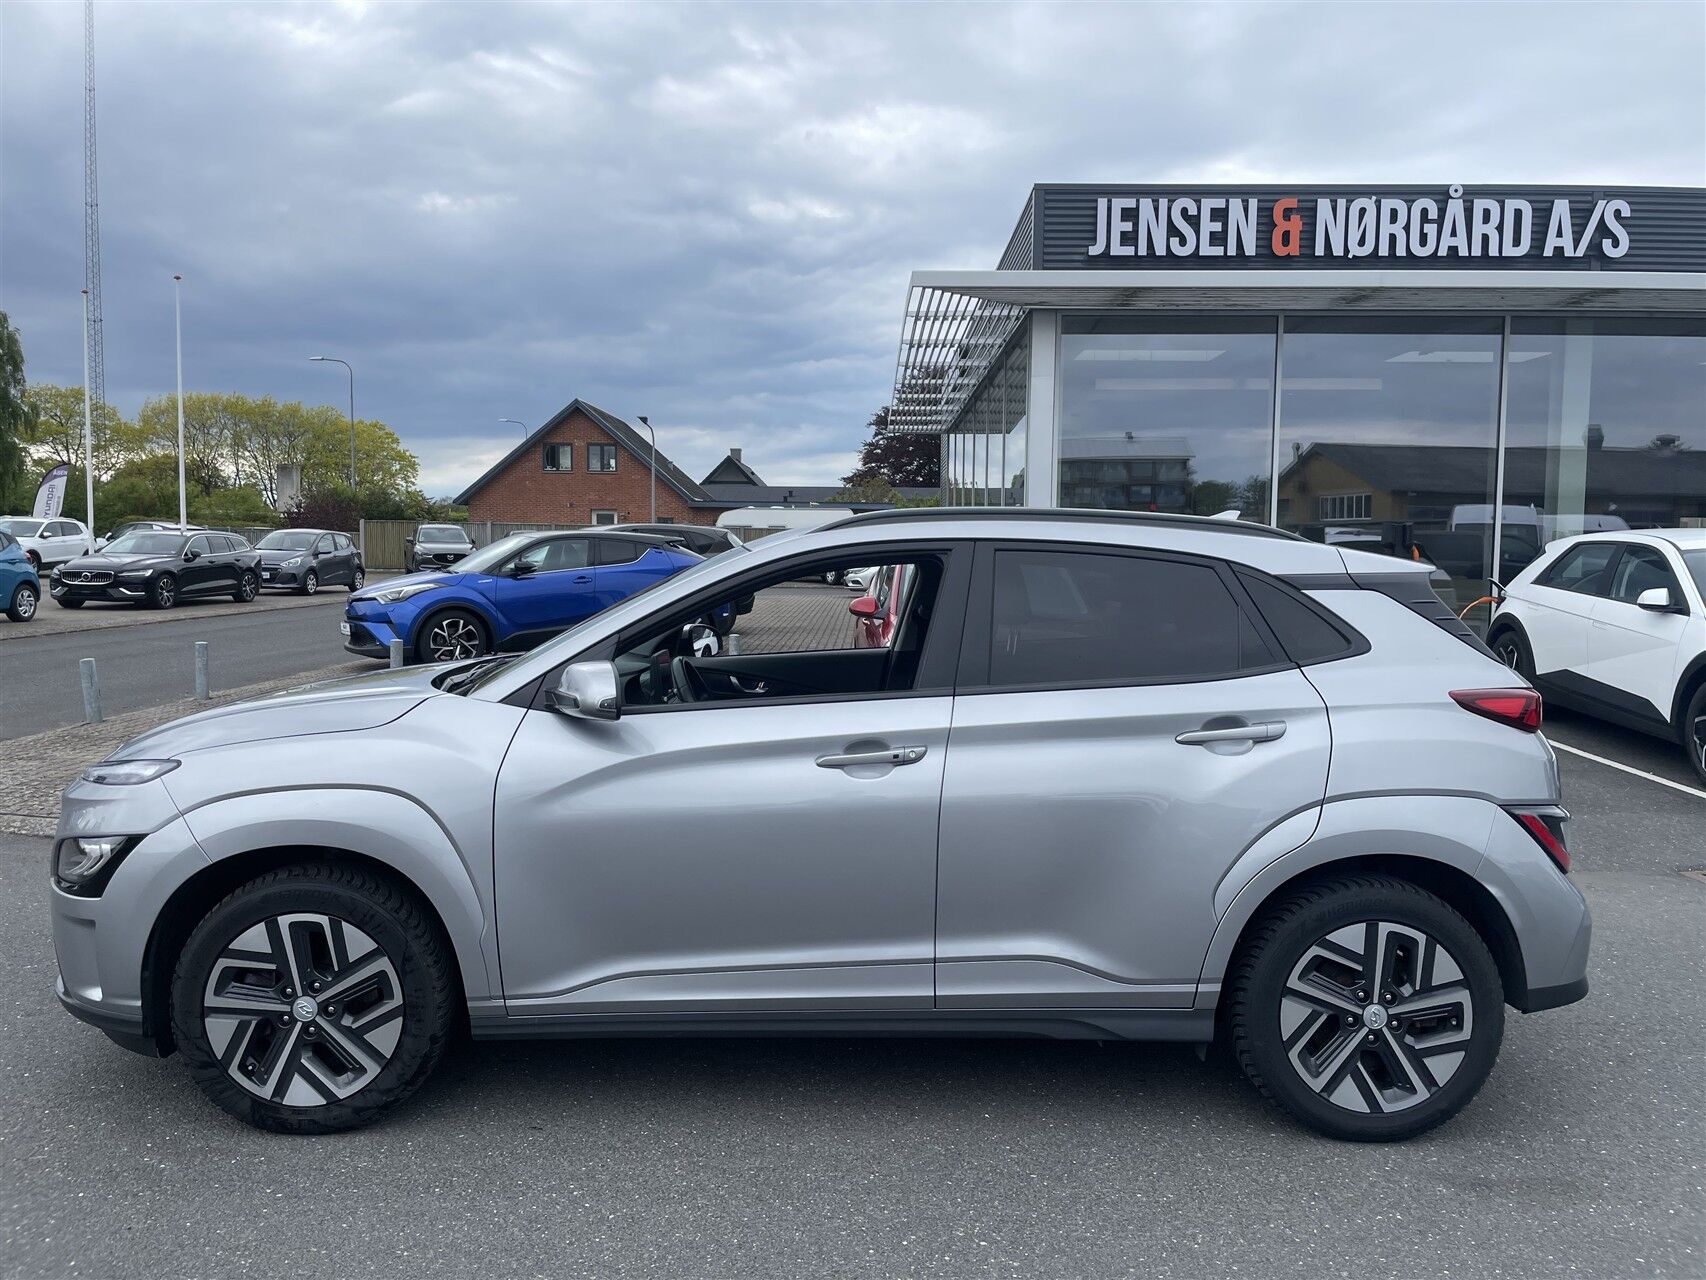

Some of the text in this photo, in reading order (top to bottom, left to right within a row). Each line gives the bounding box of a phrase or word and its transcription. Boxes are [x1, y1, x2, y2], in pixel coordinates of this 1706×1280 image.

[1088, 184, 1631, 259] JENSEN & NØRGÅRD A/S
